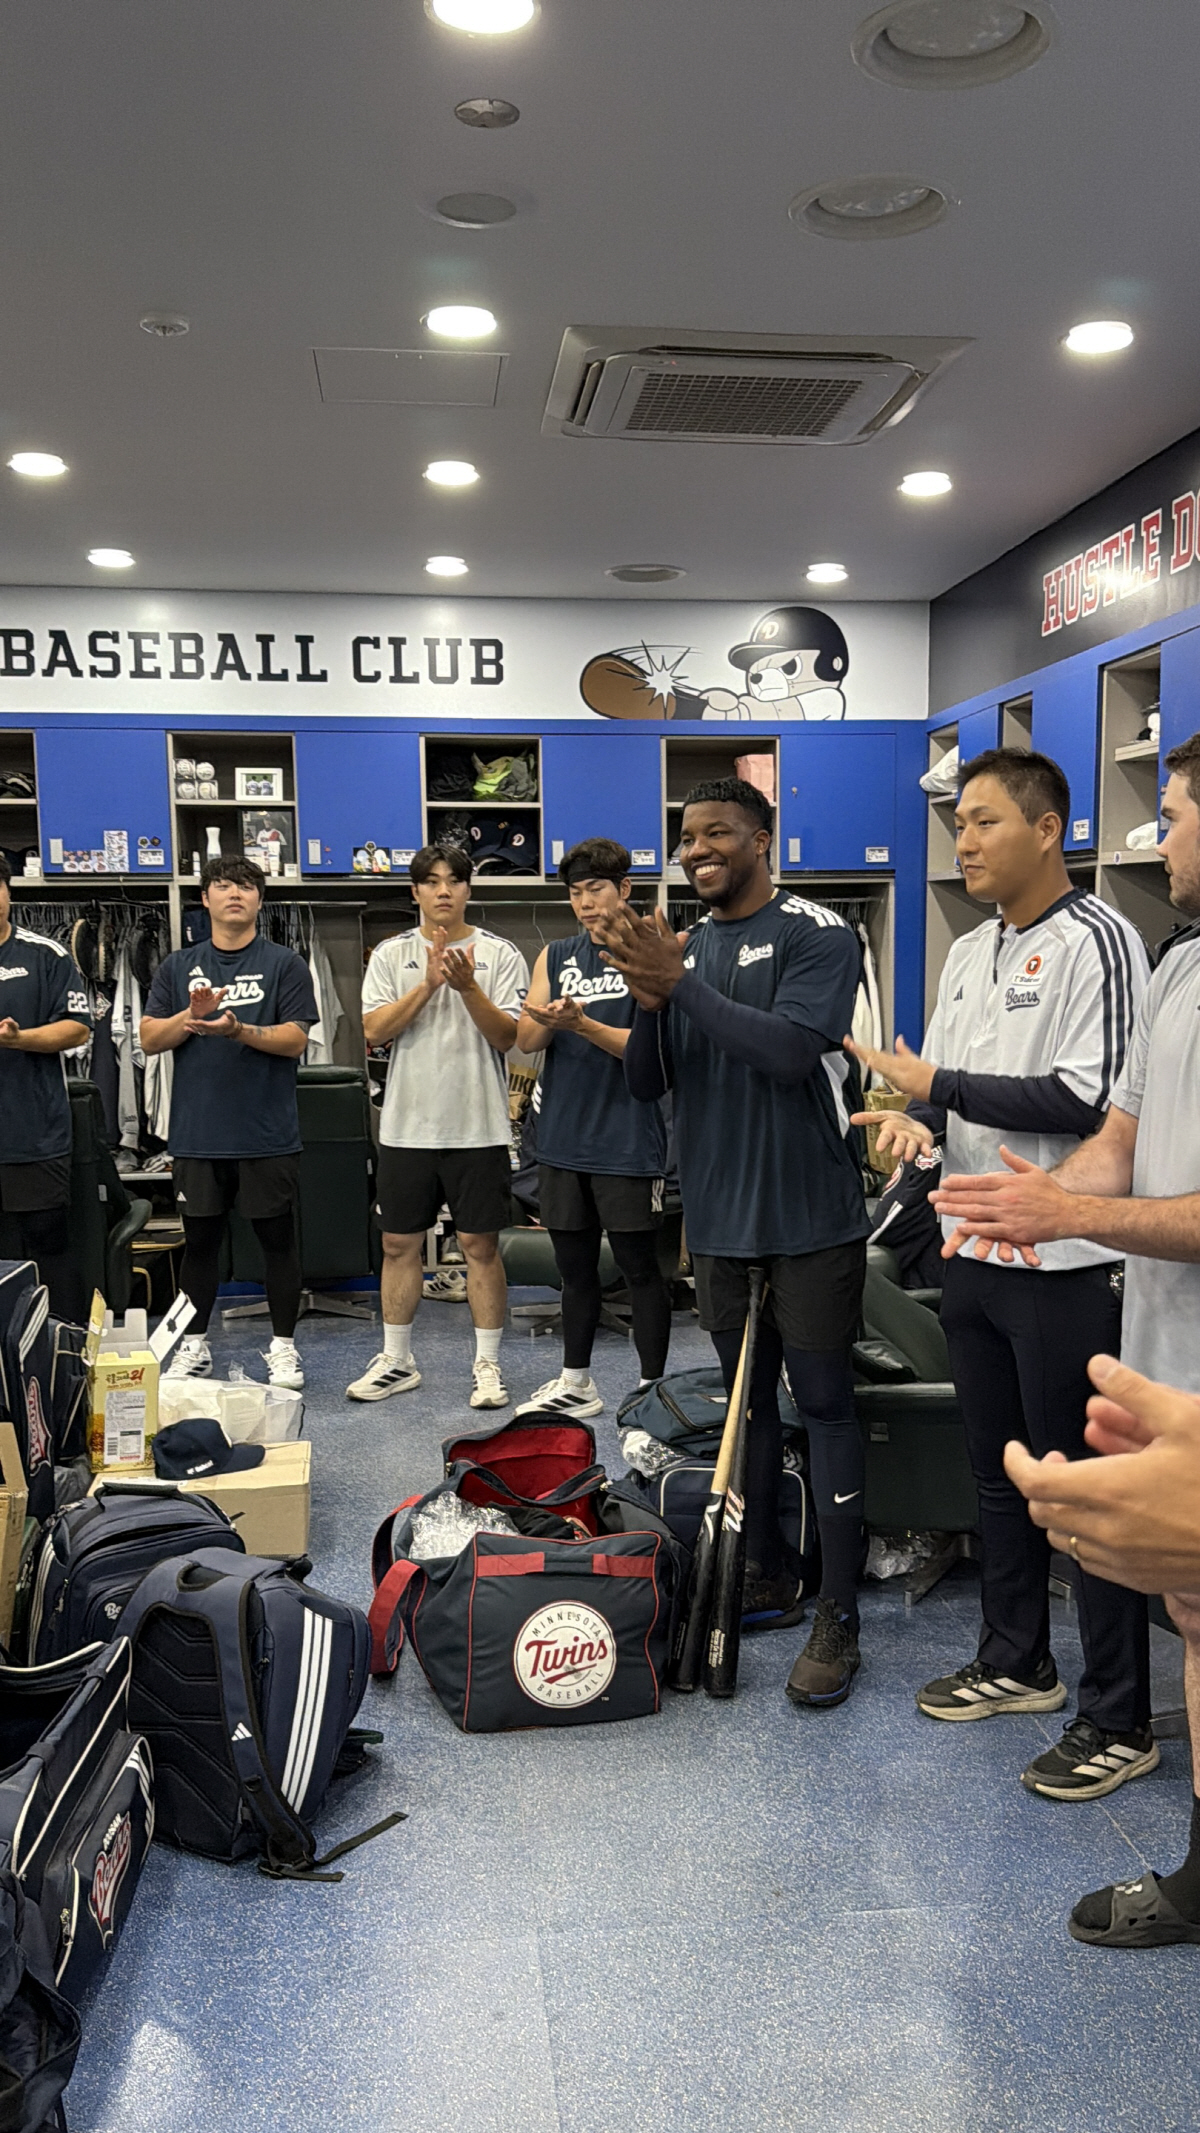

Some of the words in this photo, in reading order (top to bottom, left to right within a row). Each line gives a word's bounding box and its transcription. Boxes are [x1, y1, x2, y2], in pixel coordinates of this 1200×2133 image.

[1041, 508, 1162, 637] HUSTLE
[1170, 491, 1200, 575] D
[0, 629, 328, 682] BASEBALL
[352, 636, 504, 685] CLUB
[67, 990, 90, 1013] 22
[559, 967, 629, 1004] Bears
[1005, 987, 1041, 1012] Bears
[531, 1611, 602, 1638] MINNESOTA
[524, 1636, 608, 1685] Twins
[537, 1672, 604, 1699] BASEBALL
